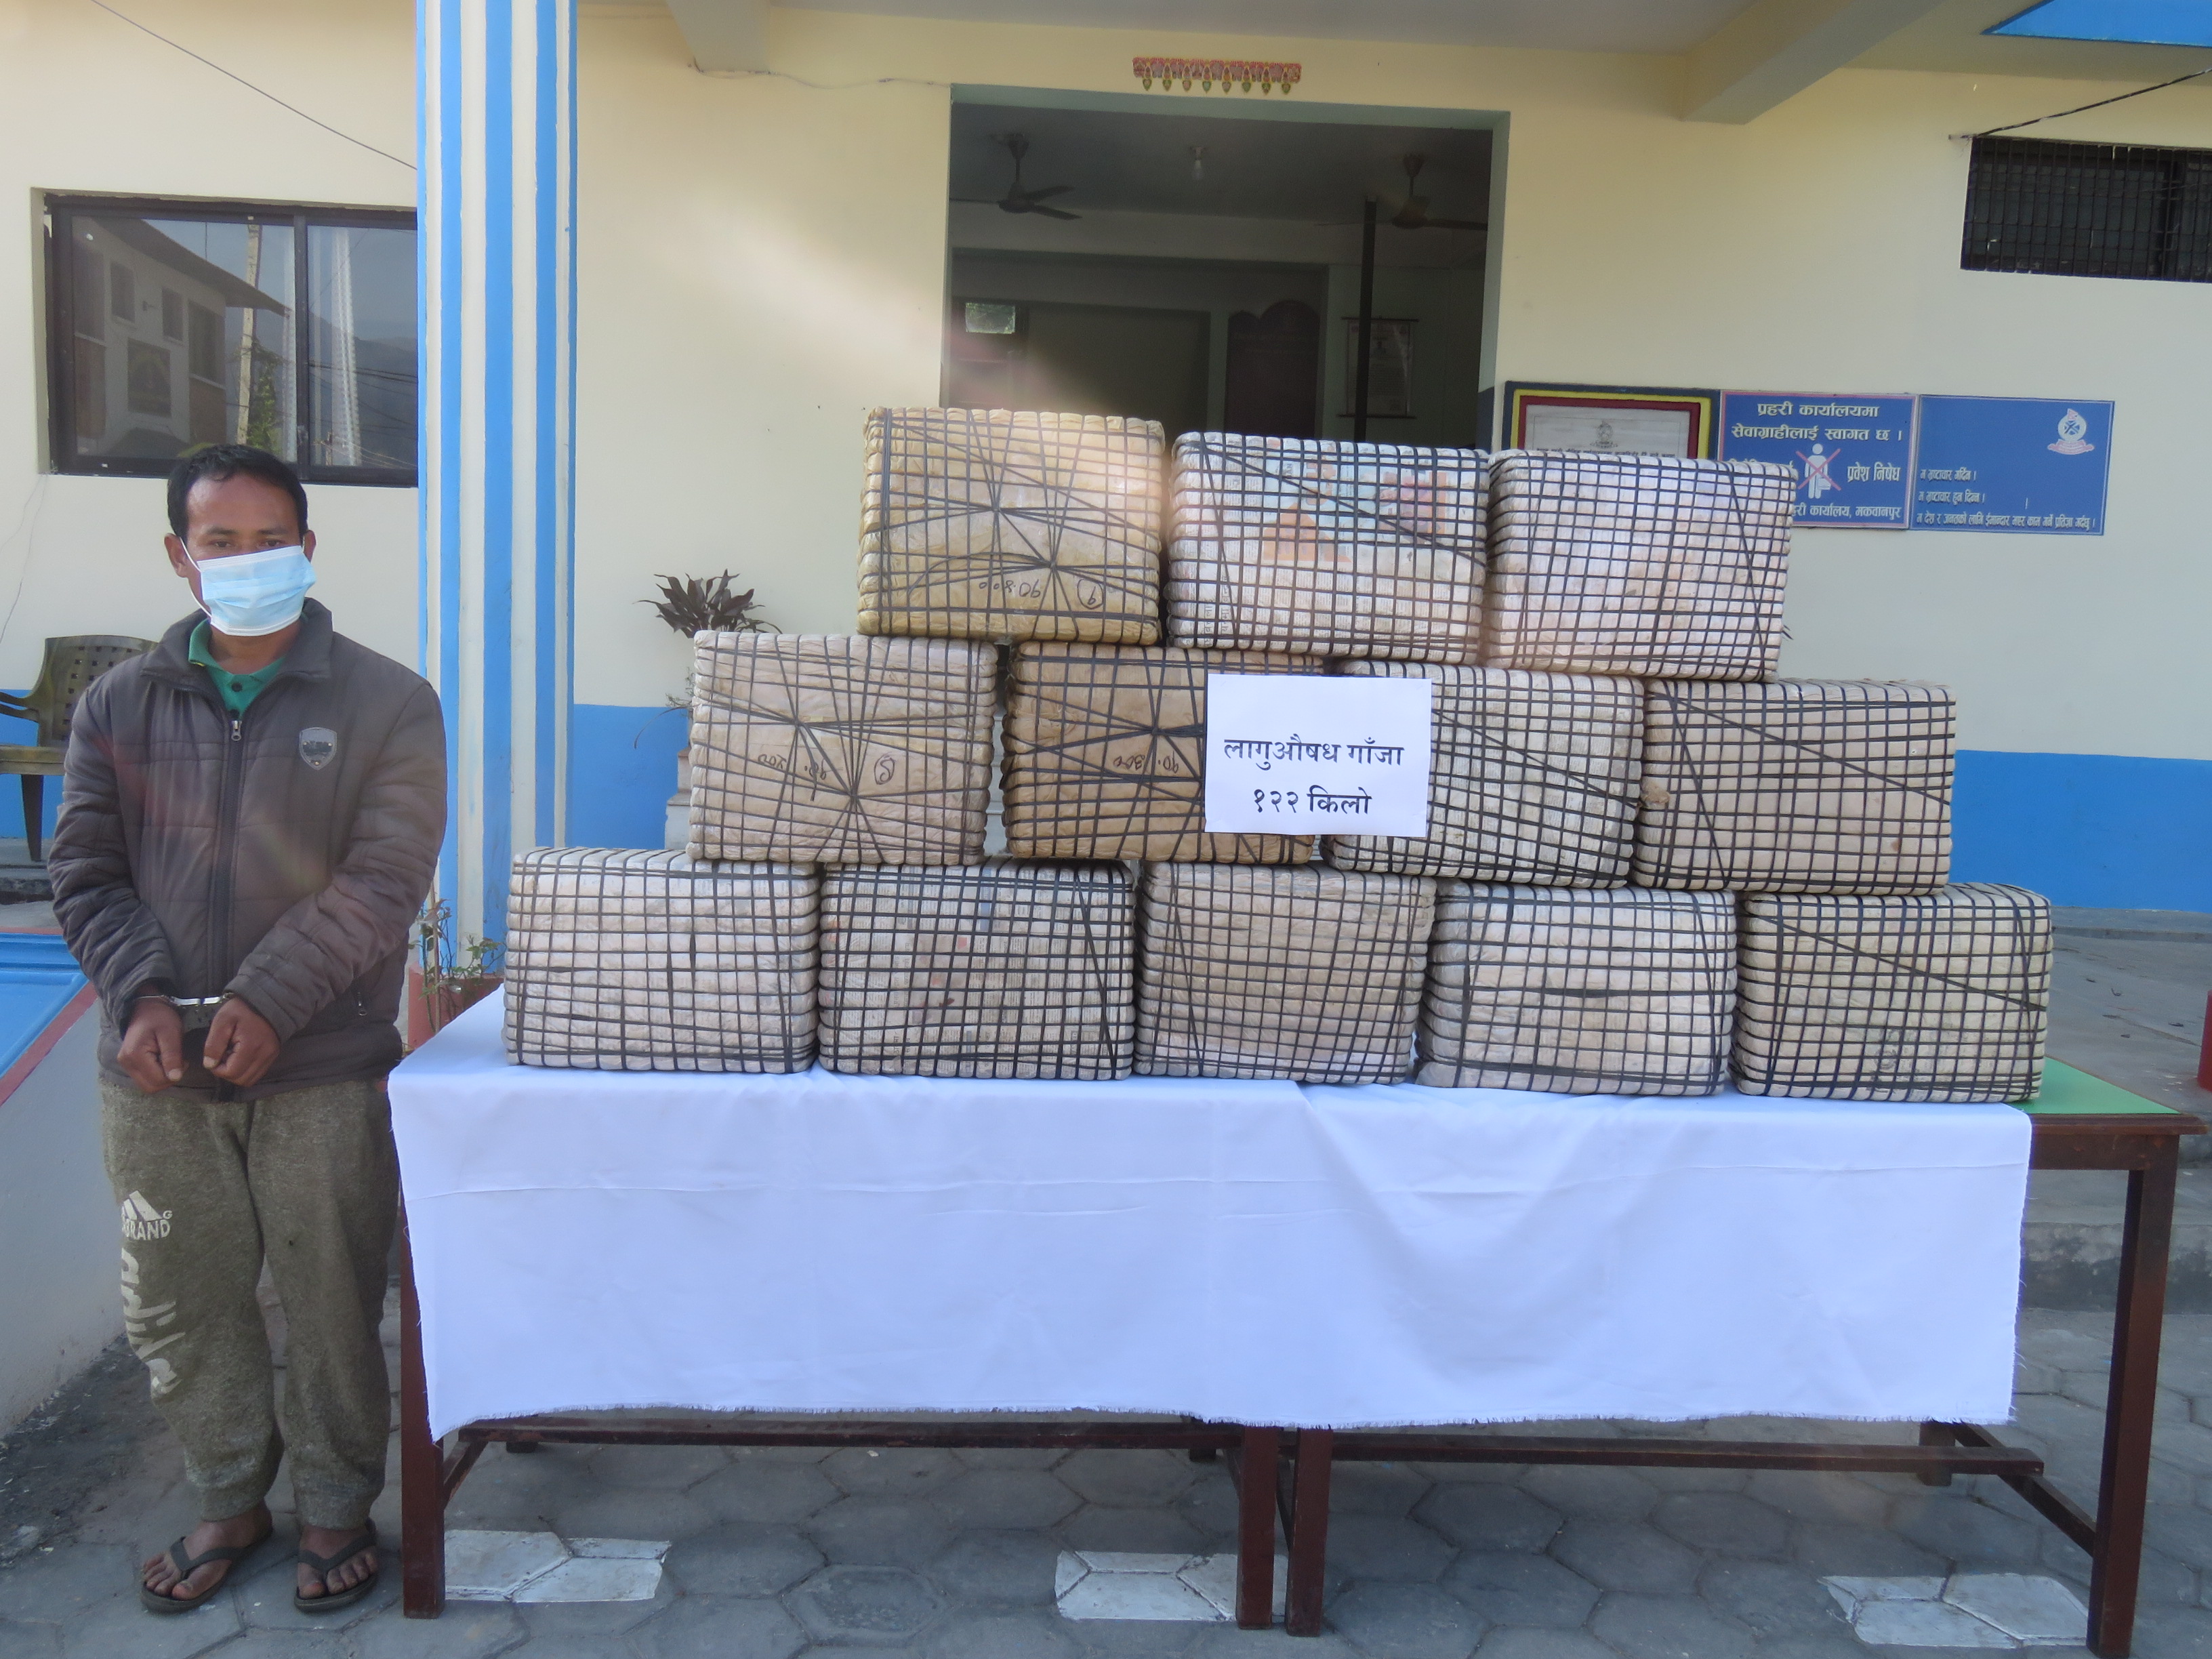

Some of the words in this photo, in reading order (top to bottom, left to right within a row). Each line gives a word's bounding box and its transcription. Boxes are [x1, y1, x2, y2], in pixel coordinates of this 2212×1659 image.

[1757, 401, 1793, 416] प्रहरी
[1799, 403, 1879, 417] कार्यालयमा
[1732, 423, 1819, 441] सेवाग्राहीलाई
[1824, 428, 1870, 441] स्वागत
[1875, 430, 1891, 441] छ
[1847, 462, 1870, 483] प्रवेश
[1873, 462, 1901, 482] निषेध
[1855, 506, 1902, 520] मकवानपुर
[1224, 733, 1340, 771] लागुऔषध
[1347, 737, 1404, 765] गाँजा
[1254, 788, 1298, 813] १२२
[1307, 785, 1372, 814] किलो
